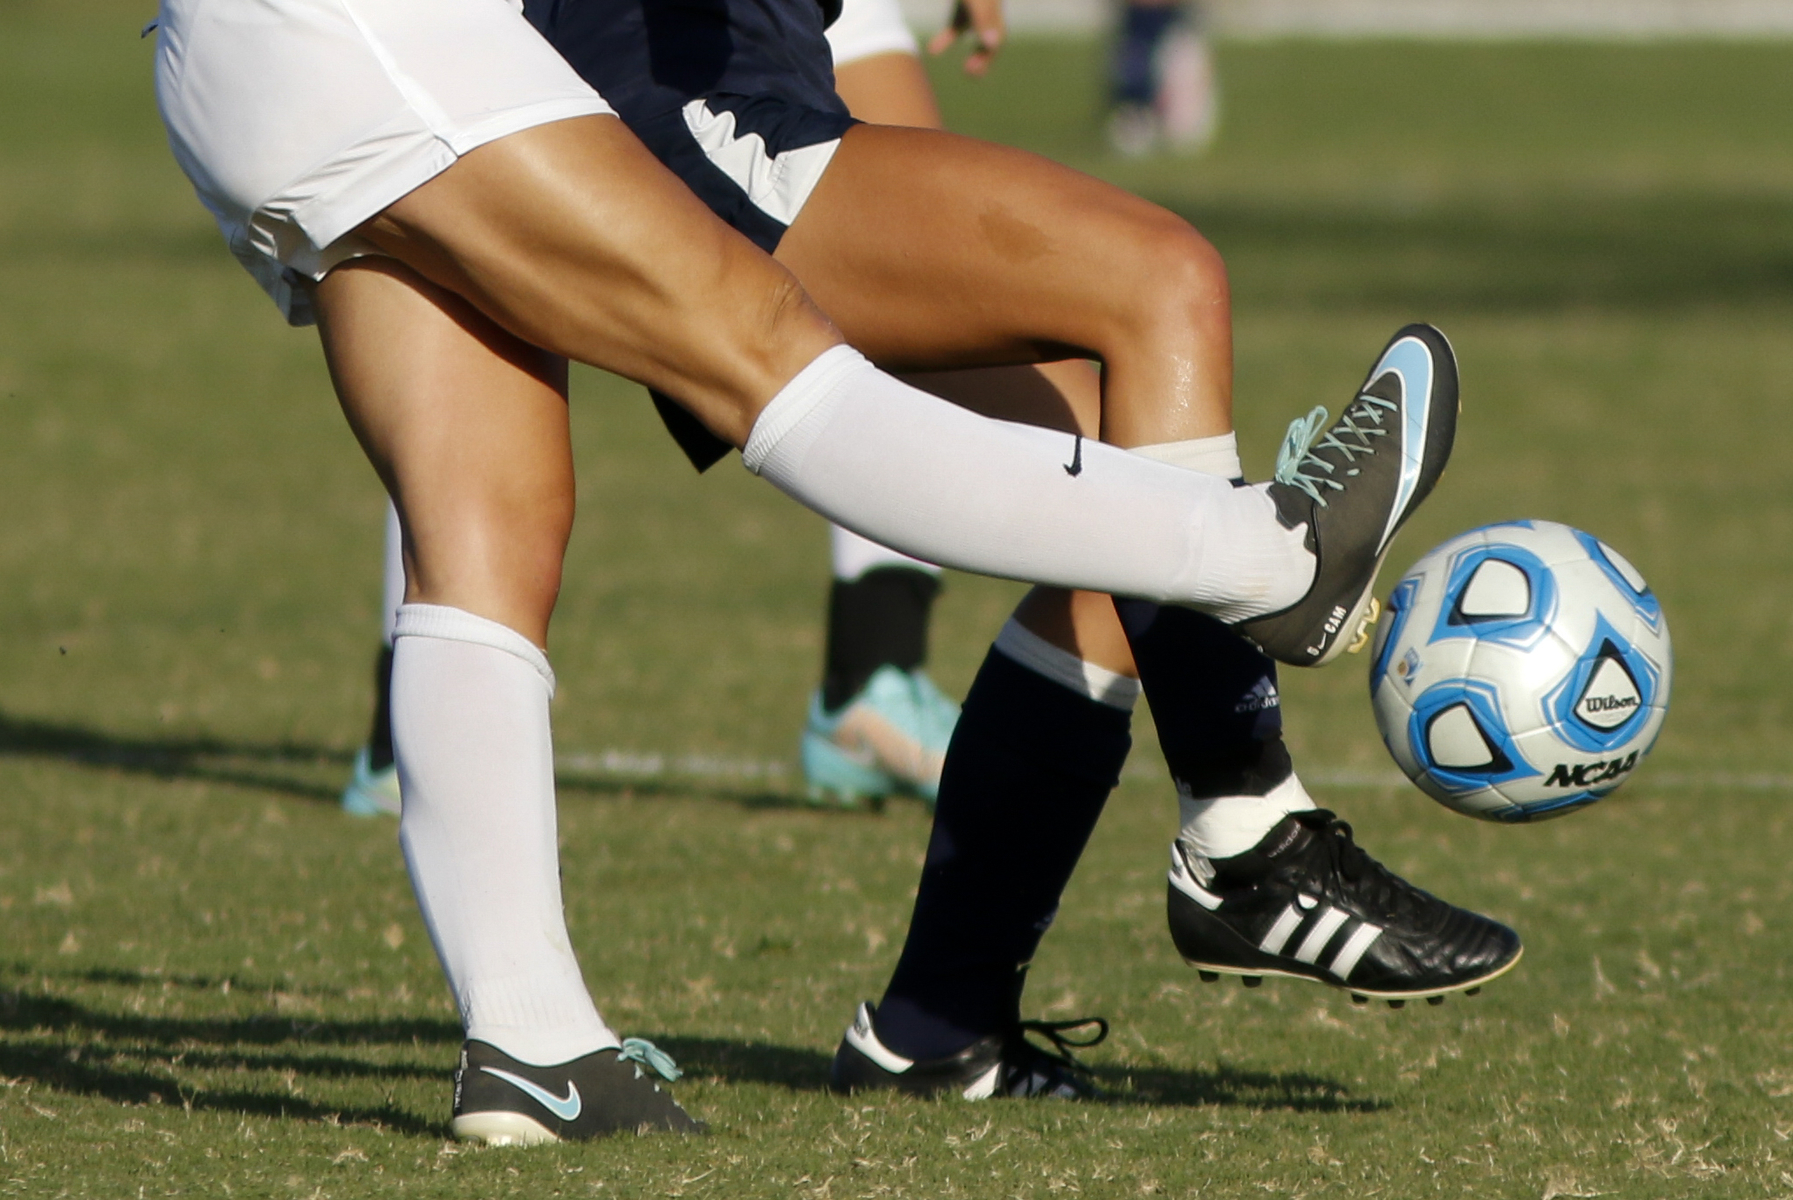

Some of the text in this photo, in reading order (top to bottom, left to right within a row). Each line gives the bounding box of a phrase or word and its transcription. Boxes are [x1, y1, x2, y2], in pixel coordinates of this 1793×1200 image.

[1323, 604, 1347, 634] CAM
[1585, 694, 1639, 713] Wilson
[1543, 749, 1640, 789] NCAA
